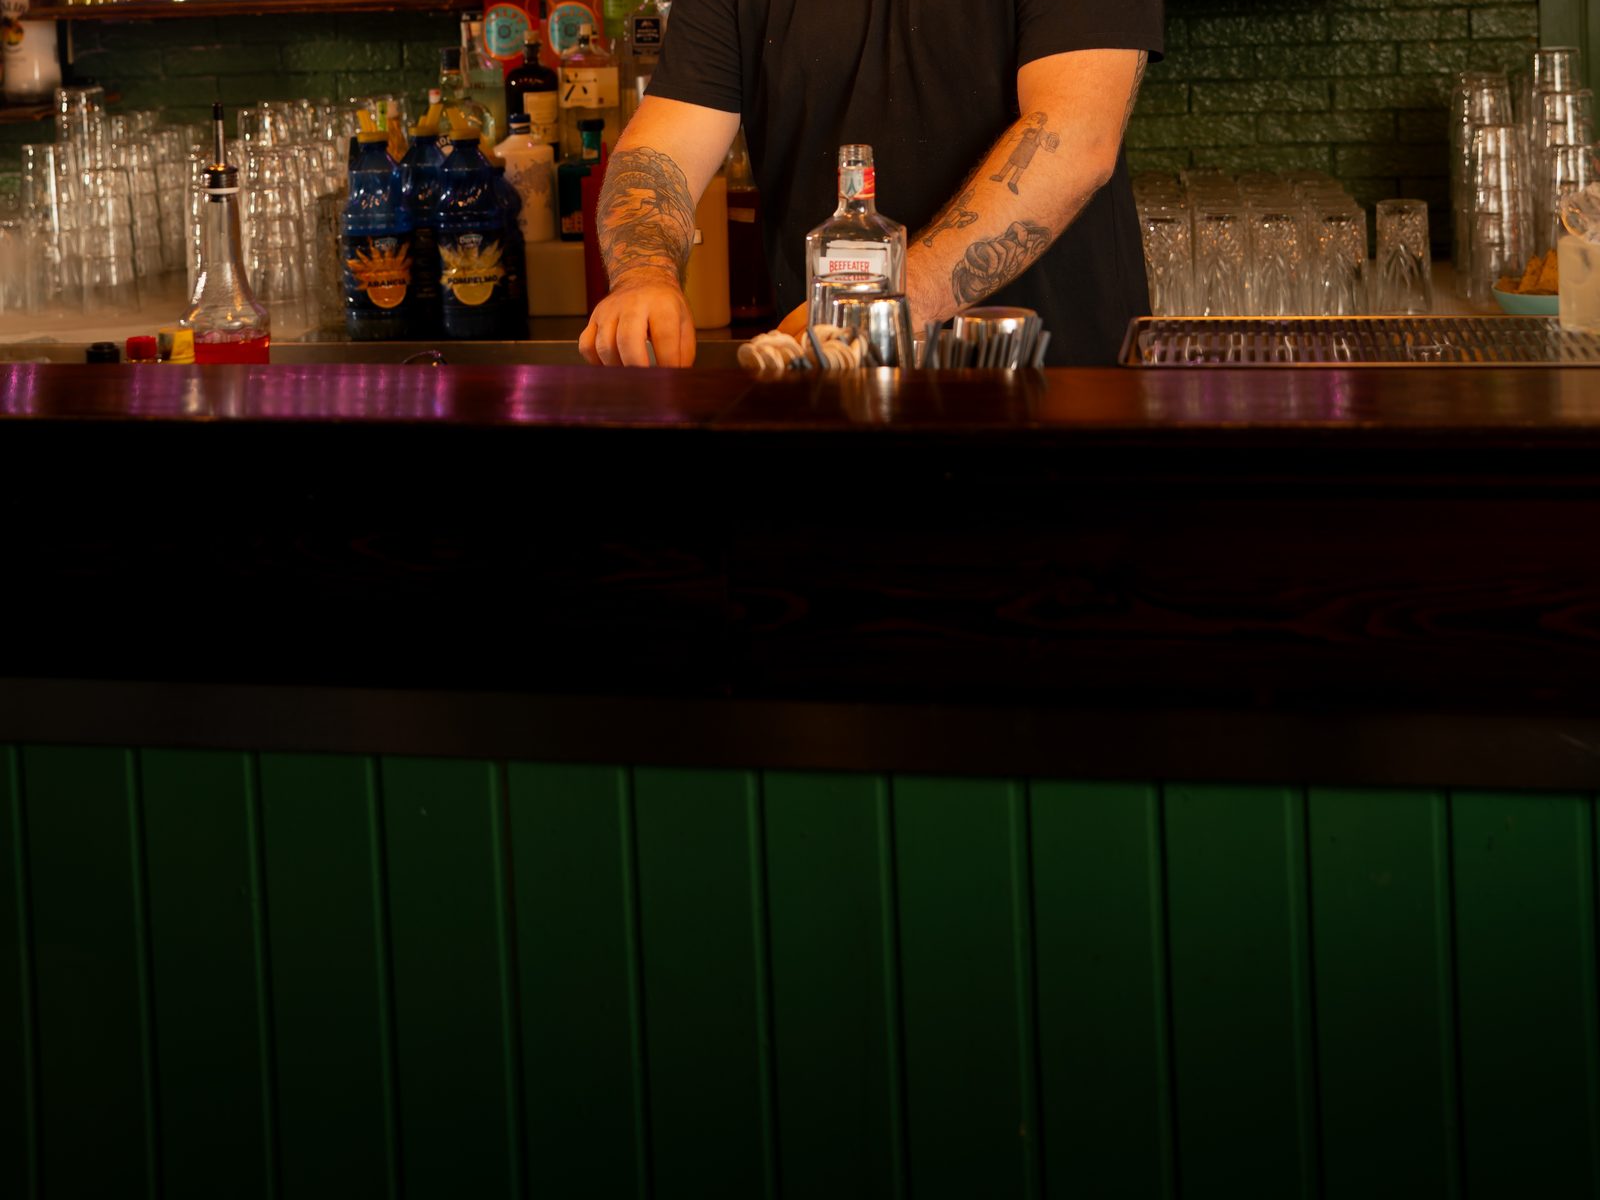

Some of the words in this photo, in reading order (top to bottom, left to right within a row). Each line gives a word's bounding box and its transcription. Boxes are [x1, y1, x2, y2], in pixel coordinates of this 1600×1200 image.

[829, 260, 870, 272] BEEFEATER
[367, 277, 407, 288] ARANCIA
[447, 274, 498, 285] POMPELMO
